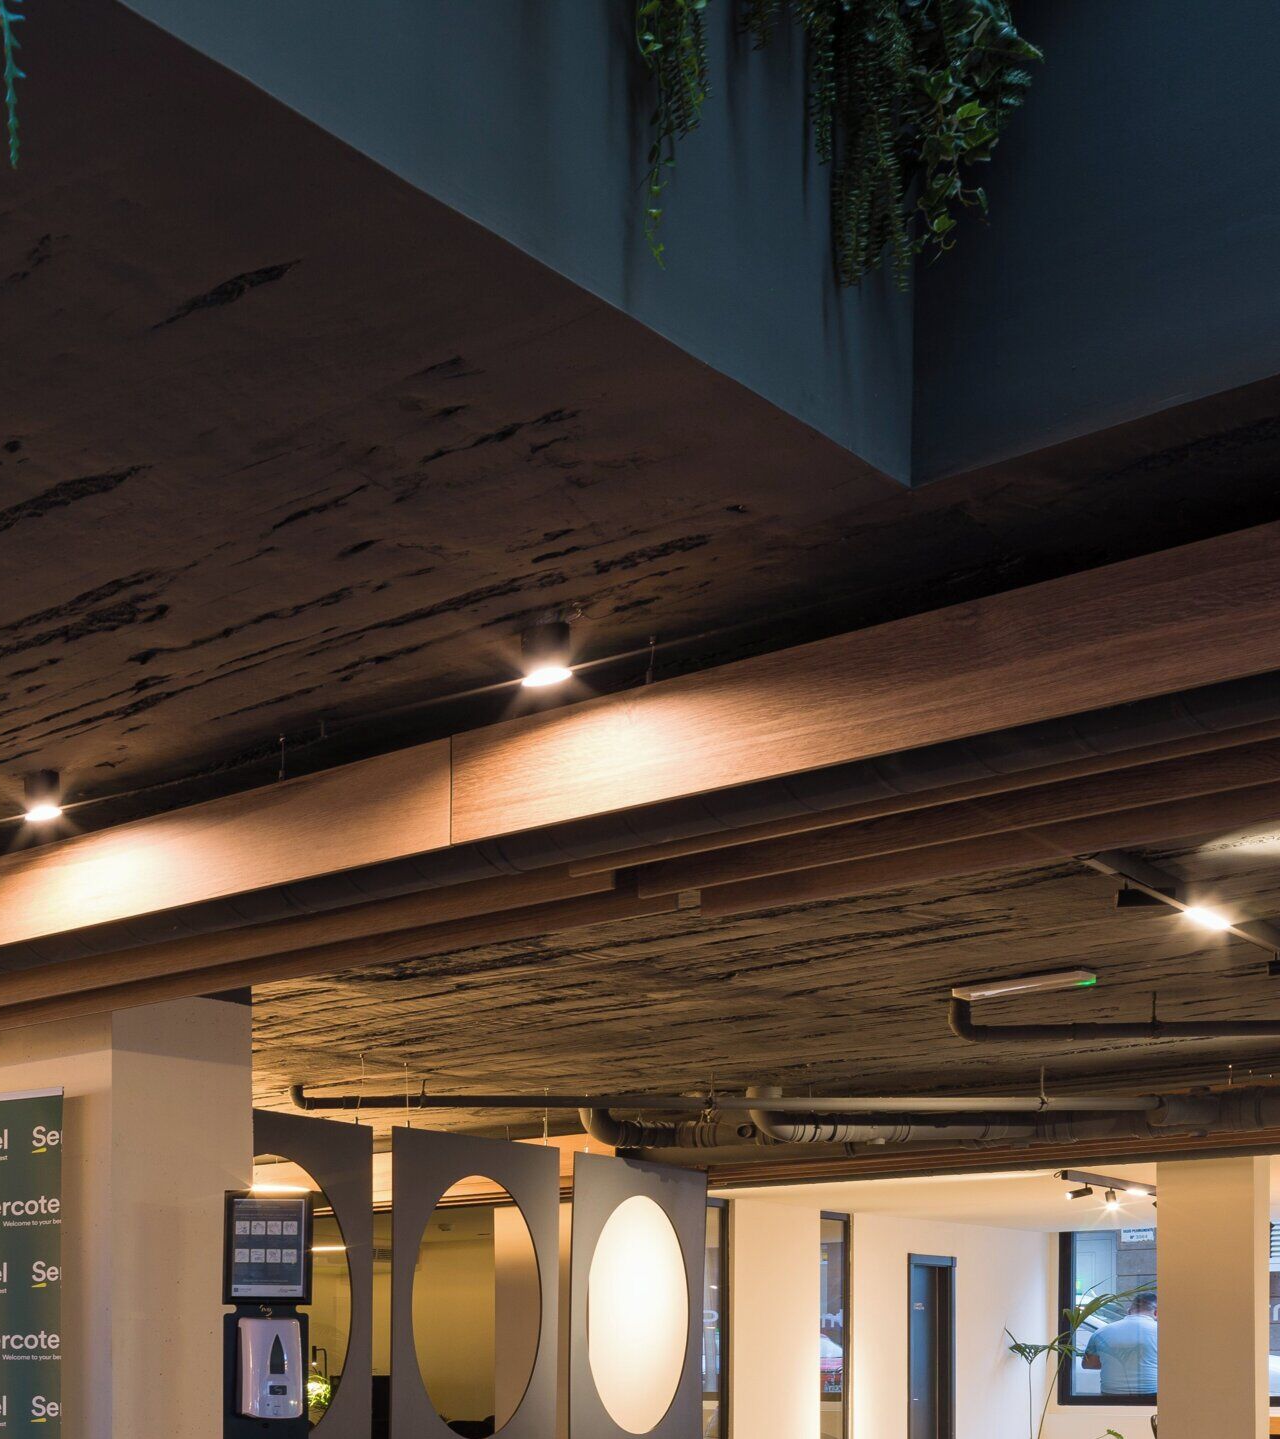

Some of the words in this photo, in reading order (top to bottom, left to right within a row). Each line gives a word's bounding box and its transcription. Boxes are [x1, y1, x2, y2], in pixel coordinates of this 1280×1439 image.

[32, 1126, 62, 1147] Se
[32, 1260, 62, 1282] Se
[31, 1395, 62, 1417] Se
